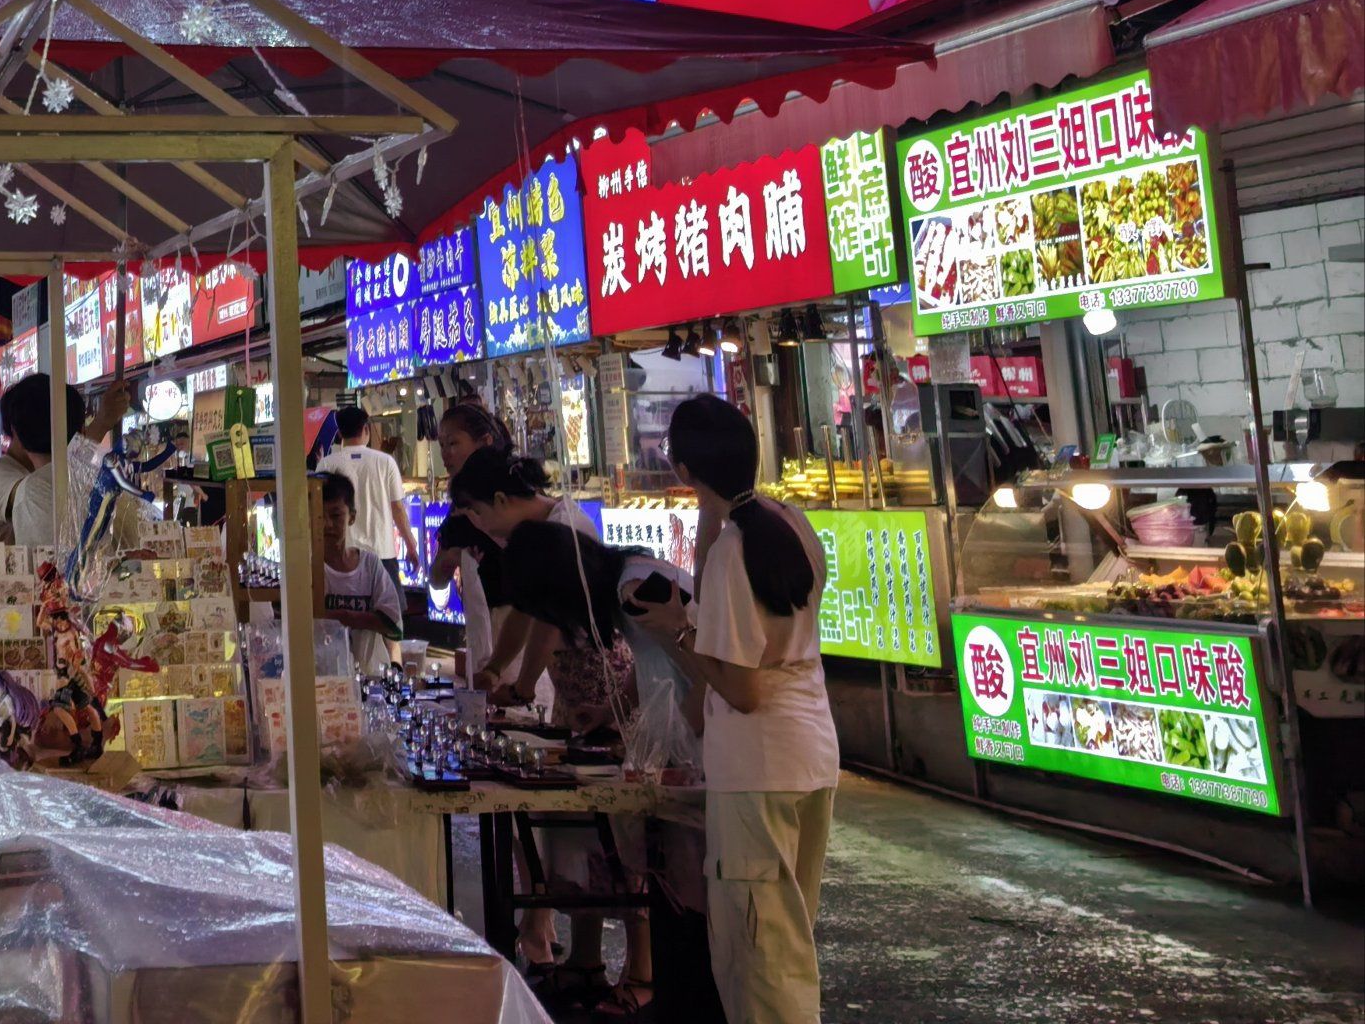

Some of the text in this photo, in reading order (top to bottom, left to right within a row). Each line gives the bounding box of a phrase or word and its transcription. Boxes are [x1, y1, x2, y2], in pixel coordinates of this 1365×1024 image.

[597, 159, 648, 199] 柳州手信
[907, 151, 941, 204] 酸
[600, 167, 807, 298] 炭烤猪肉脯
[969, 641, 1009, 702] 酸
[1017, 626, 1252, 710] 宜州刘三姐口味酸
